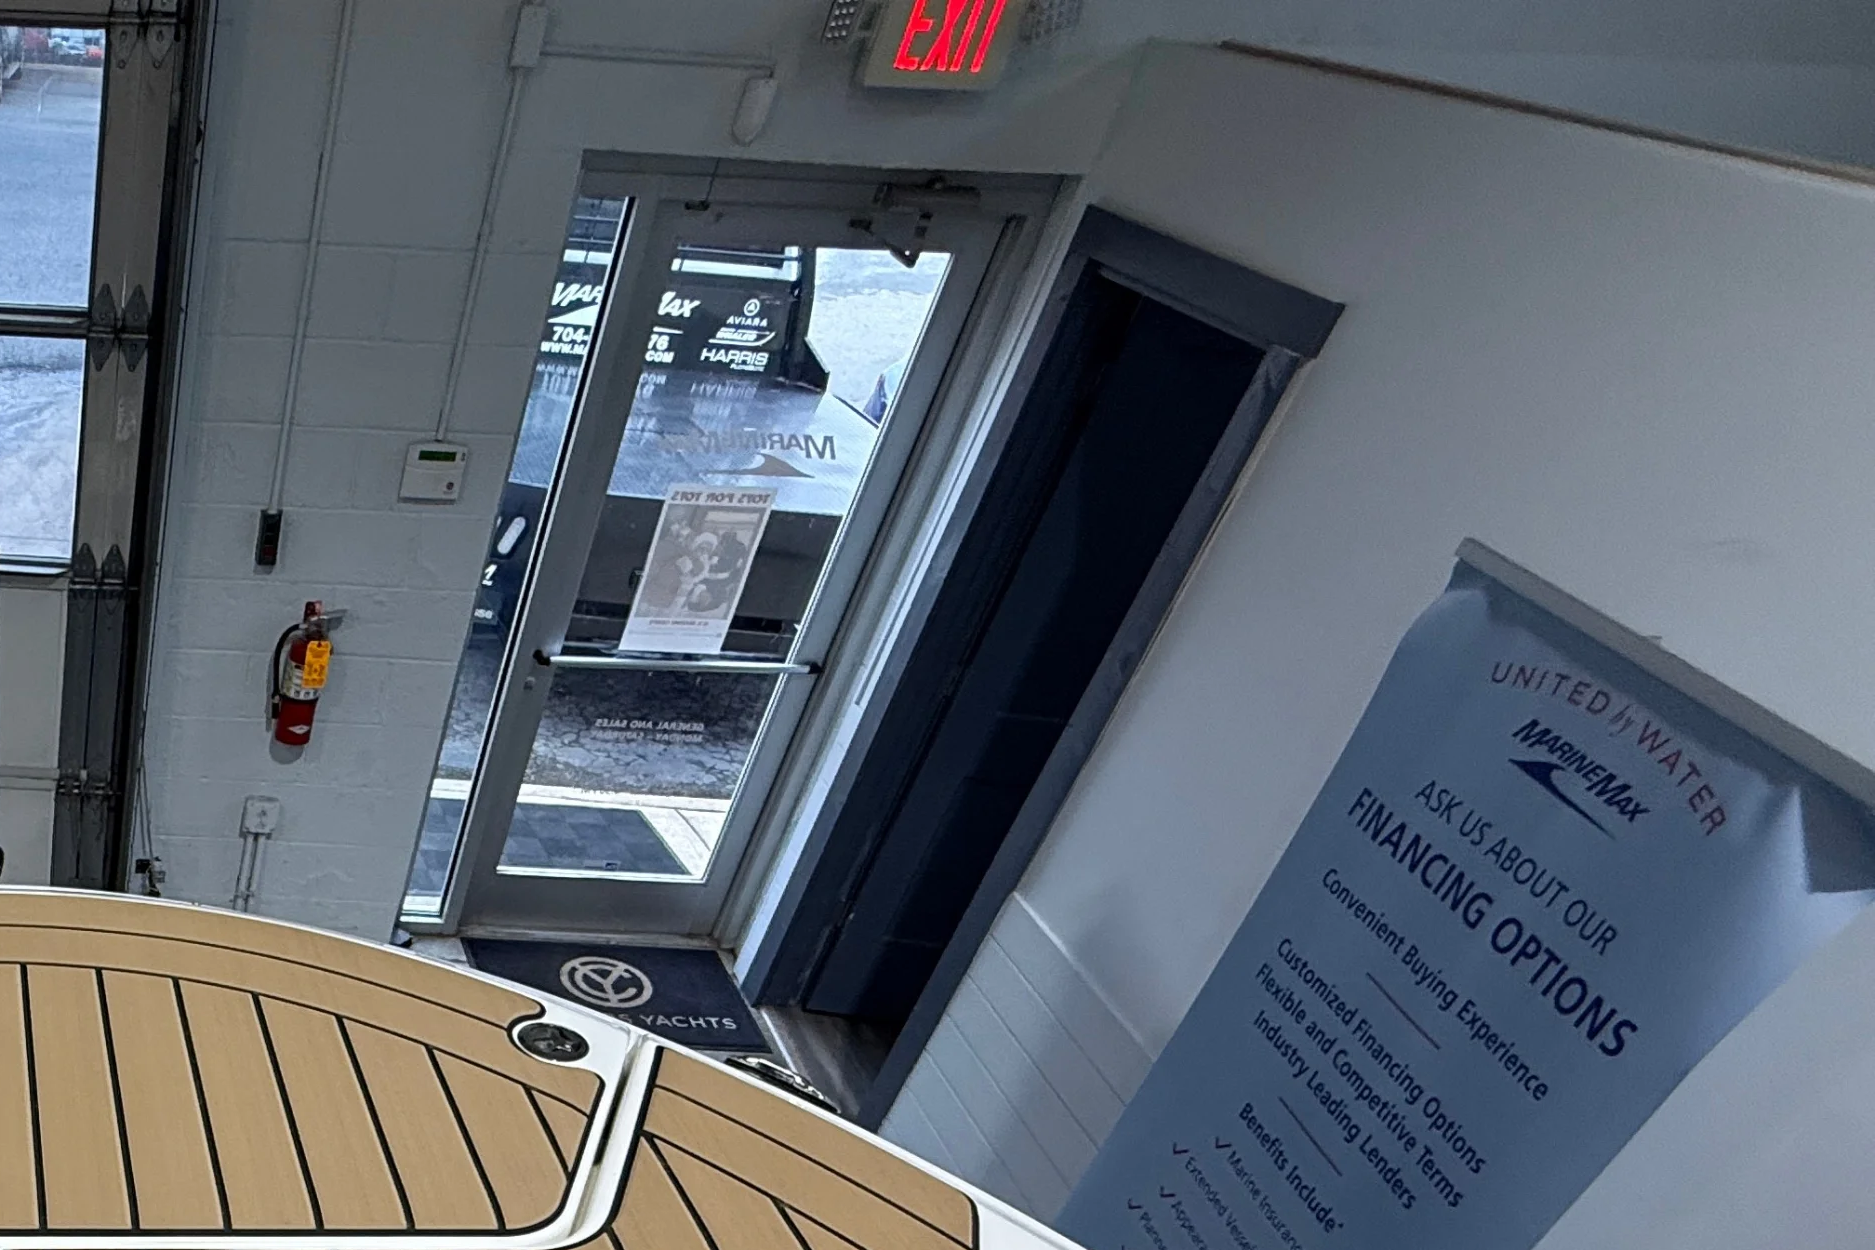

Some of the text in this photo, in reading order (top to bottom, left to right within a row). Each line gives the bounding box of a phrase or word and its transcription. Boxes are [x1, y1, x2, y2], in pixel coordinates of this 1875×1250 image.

[700, 348, 769, 366] HARRIS
[726, 315, 768, 327] AVIARA
[1491, 662, 1611, 715] UNITED
[1636, 720, 1726, 836] WATER
[1348, 787, 1638, 1057] FINANCING OPTIONS
[1415, 780, 1617, 956] ASK US ABOUT OUR
[639, 1015, 737, 1030] YACHTS
[1277, 938, 1486, 1174] Customized Financing Options
[1322, 868, 1549, 1101] Convenient Buying Experience
[1238, 1102, 1289, 1172] Benefits
[1253, 1011, 1417, 1210] Industry Leading Lenders
[1255, 963, 1464, 1208] Flexible and Competitive Terms
[1185, 1156, 1229, 1217] Extended
[1227, 1150, 1262, 1200] Marine
